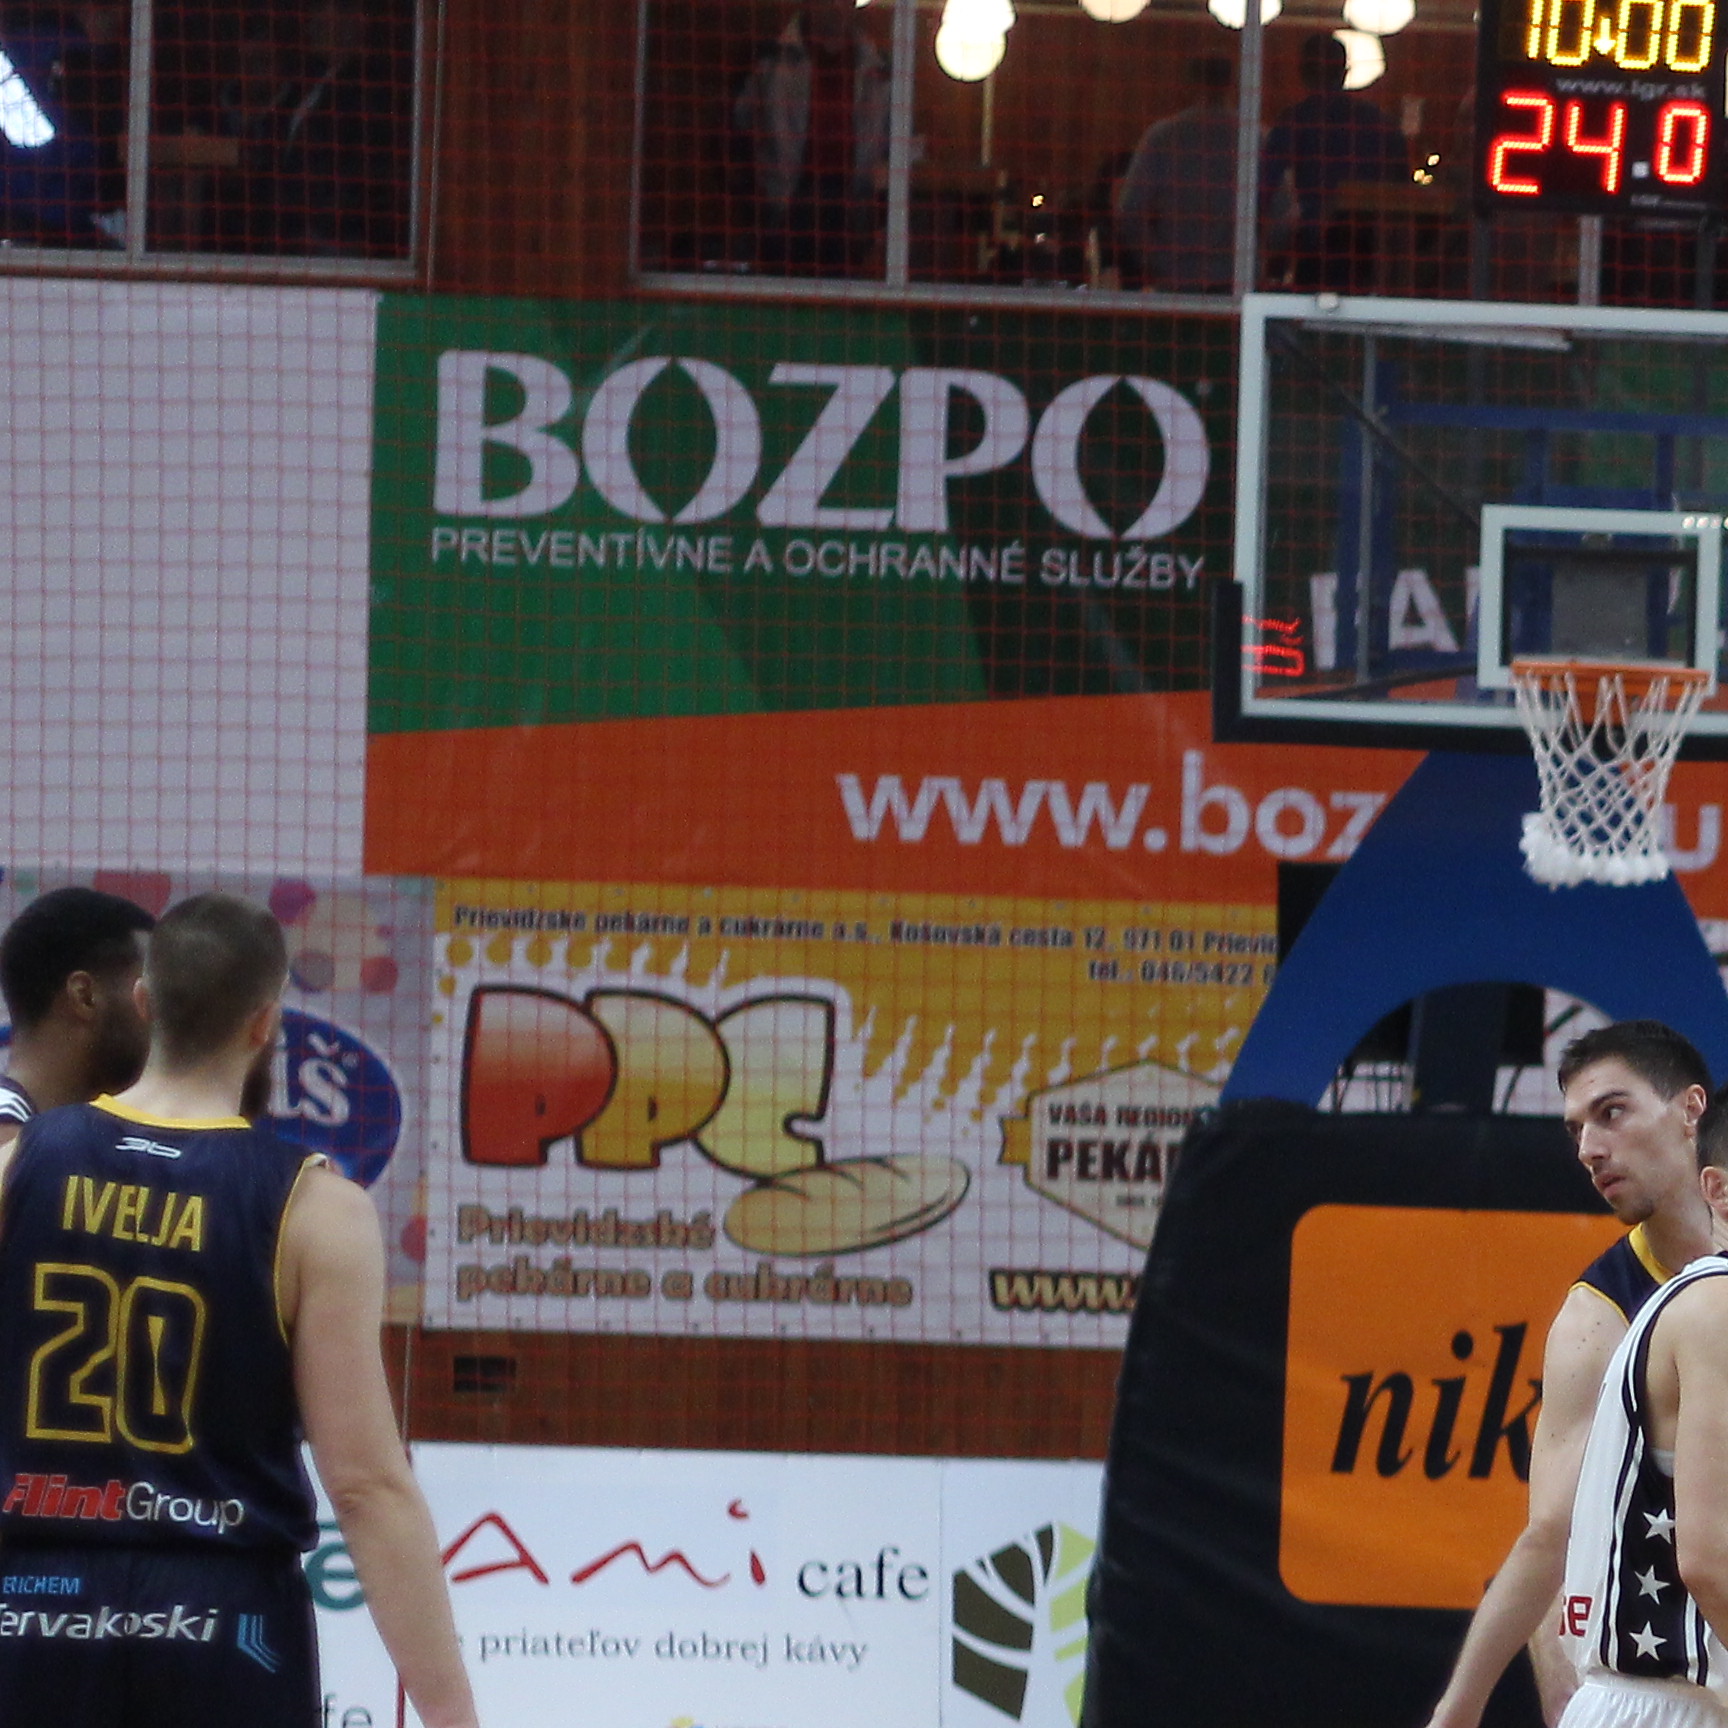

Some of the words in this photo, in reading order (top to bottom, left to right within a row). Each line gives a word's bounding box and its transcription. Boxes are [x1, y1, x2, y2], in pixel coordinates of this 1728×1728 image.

[434, 349, 1212, 540] BOZPO
[431, 524, 733, 575] PREVENTÍVNE
[743, 541, 774, 576] A
[786, 538, 1025, 585] OCHRANNÉ
[1040, 545, 1204, 591] SLUŽBY
[62, 1174, 206, 1253] IVELJA
[27, 1262, 208, 1455] 20
[1330, 1322, 1544, 1485] nik
[796, 1546, 932, 1602] cafe
[0, 1603, 220, 1643] ervakoski
[479, 1626, 641, 1662] priateľov
[653, 1628, 770, 1667] dobrej
[782, 1631, 869, 1669] kávy
